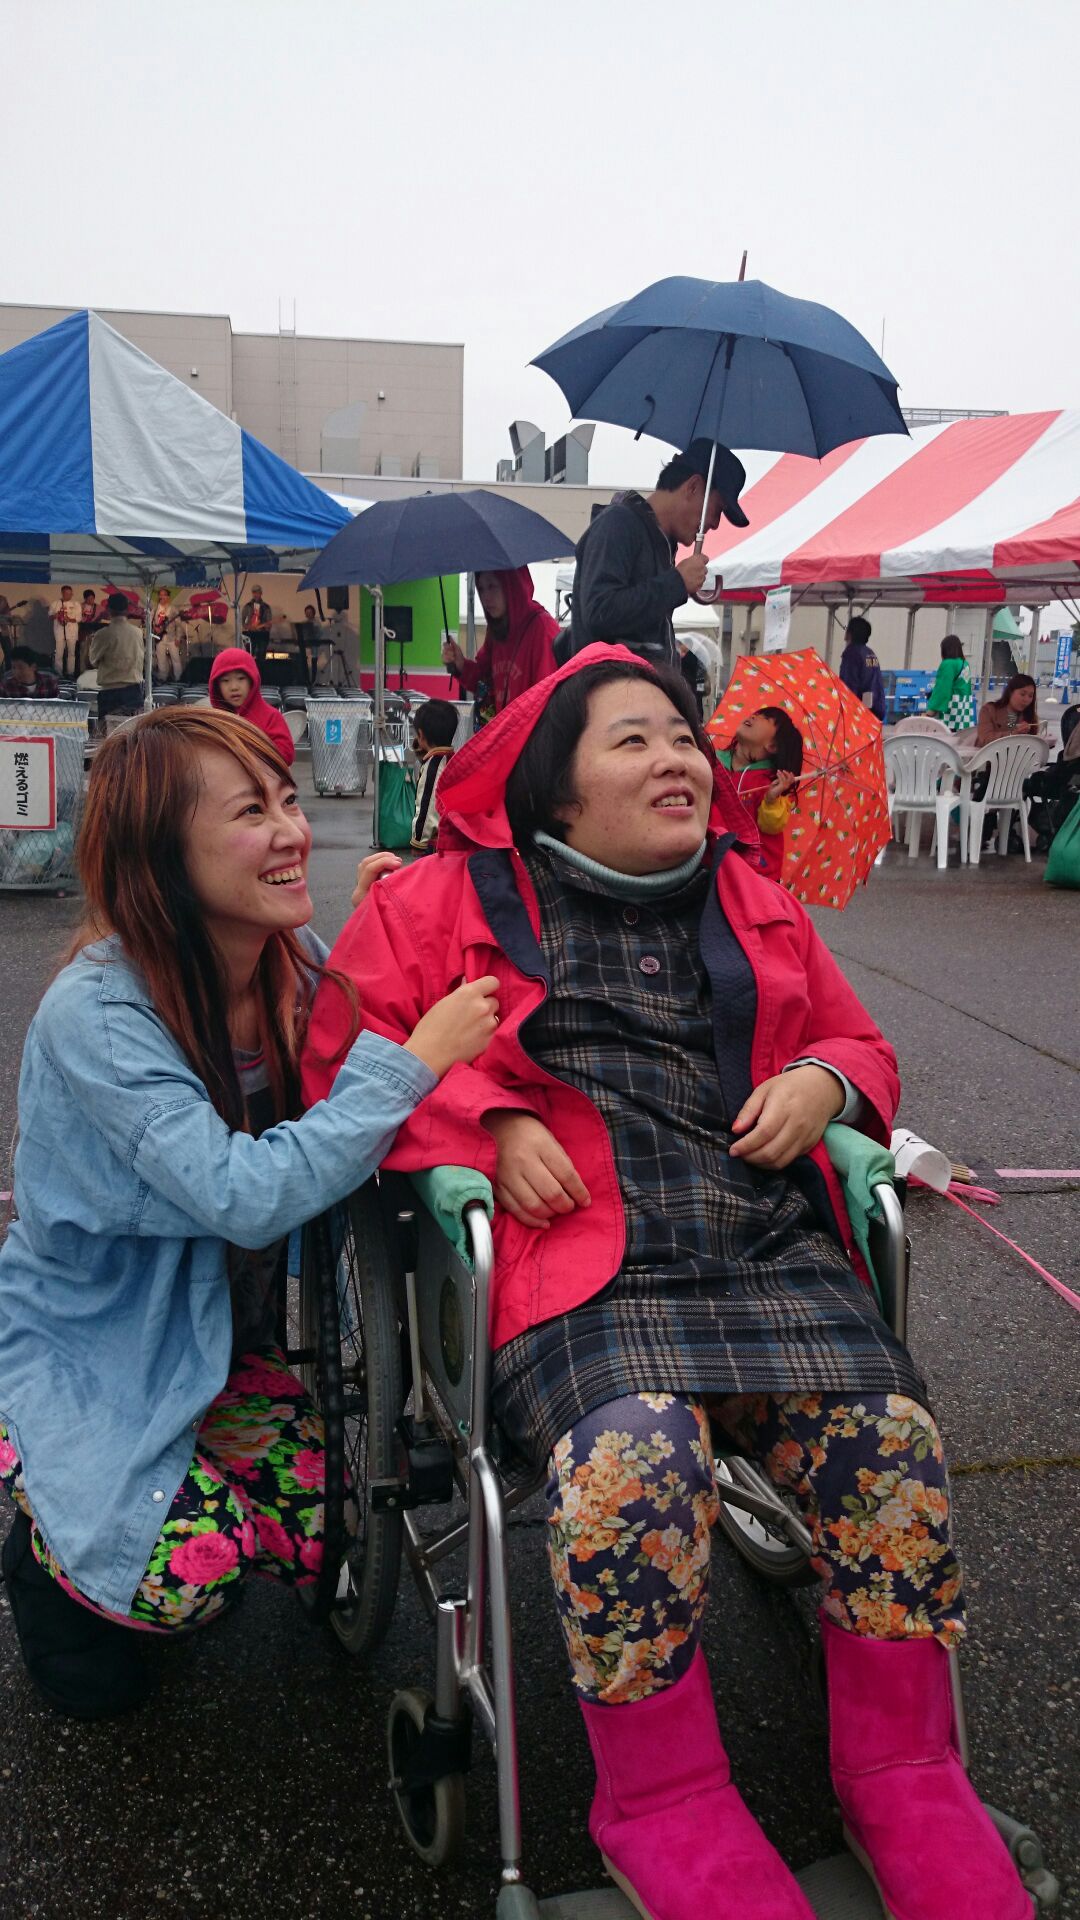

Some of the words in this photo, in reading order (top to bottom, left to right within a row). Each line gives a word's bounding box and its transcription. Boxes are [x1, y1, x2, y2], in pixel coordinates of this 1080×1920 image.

[14, 752, 29, 816] 燃えるゴミ
